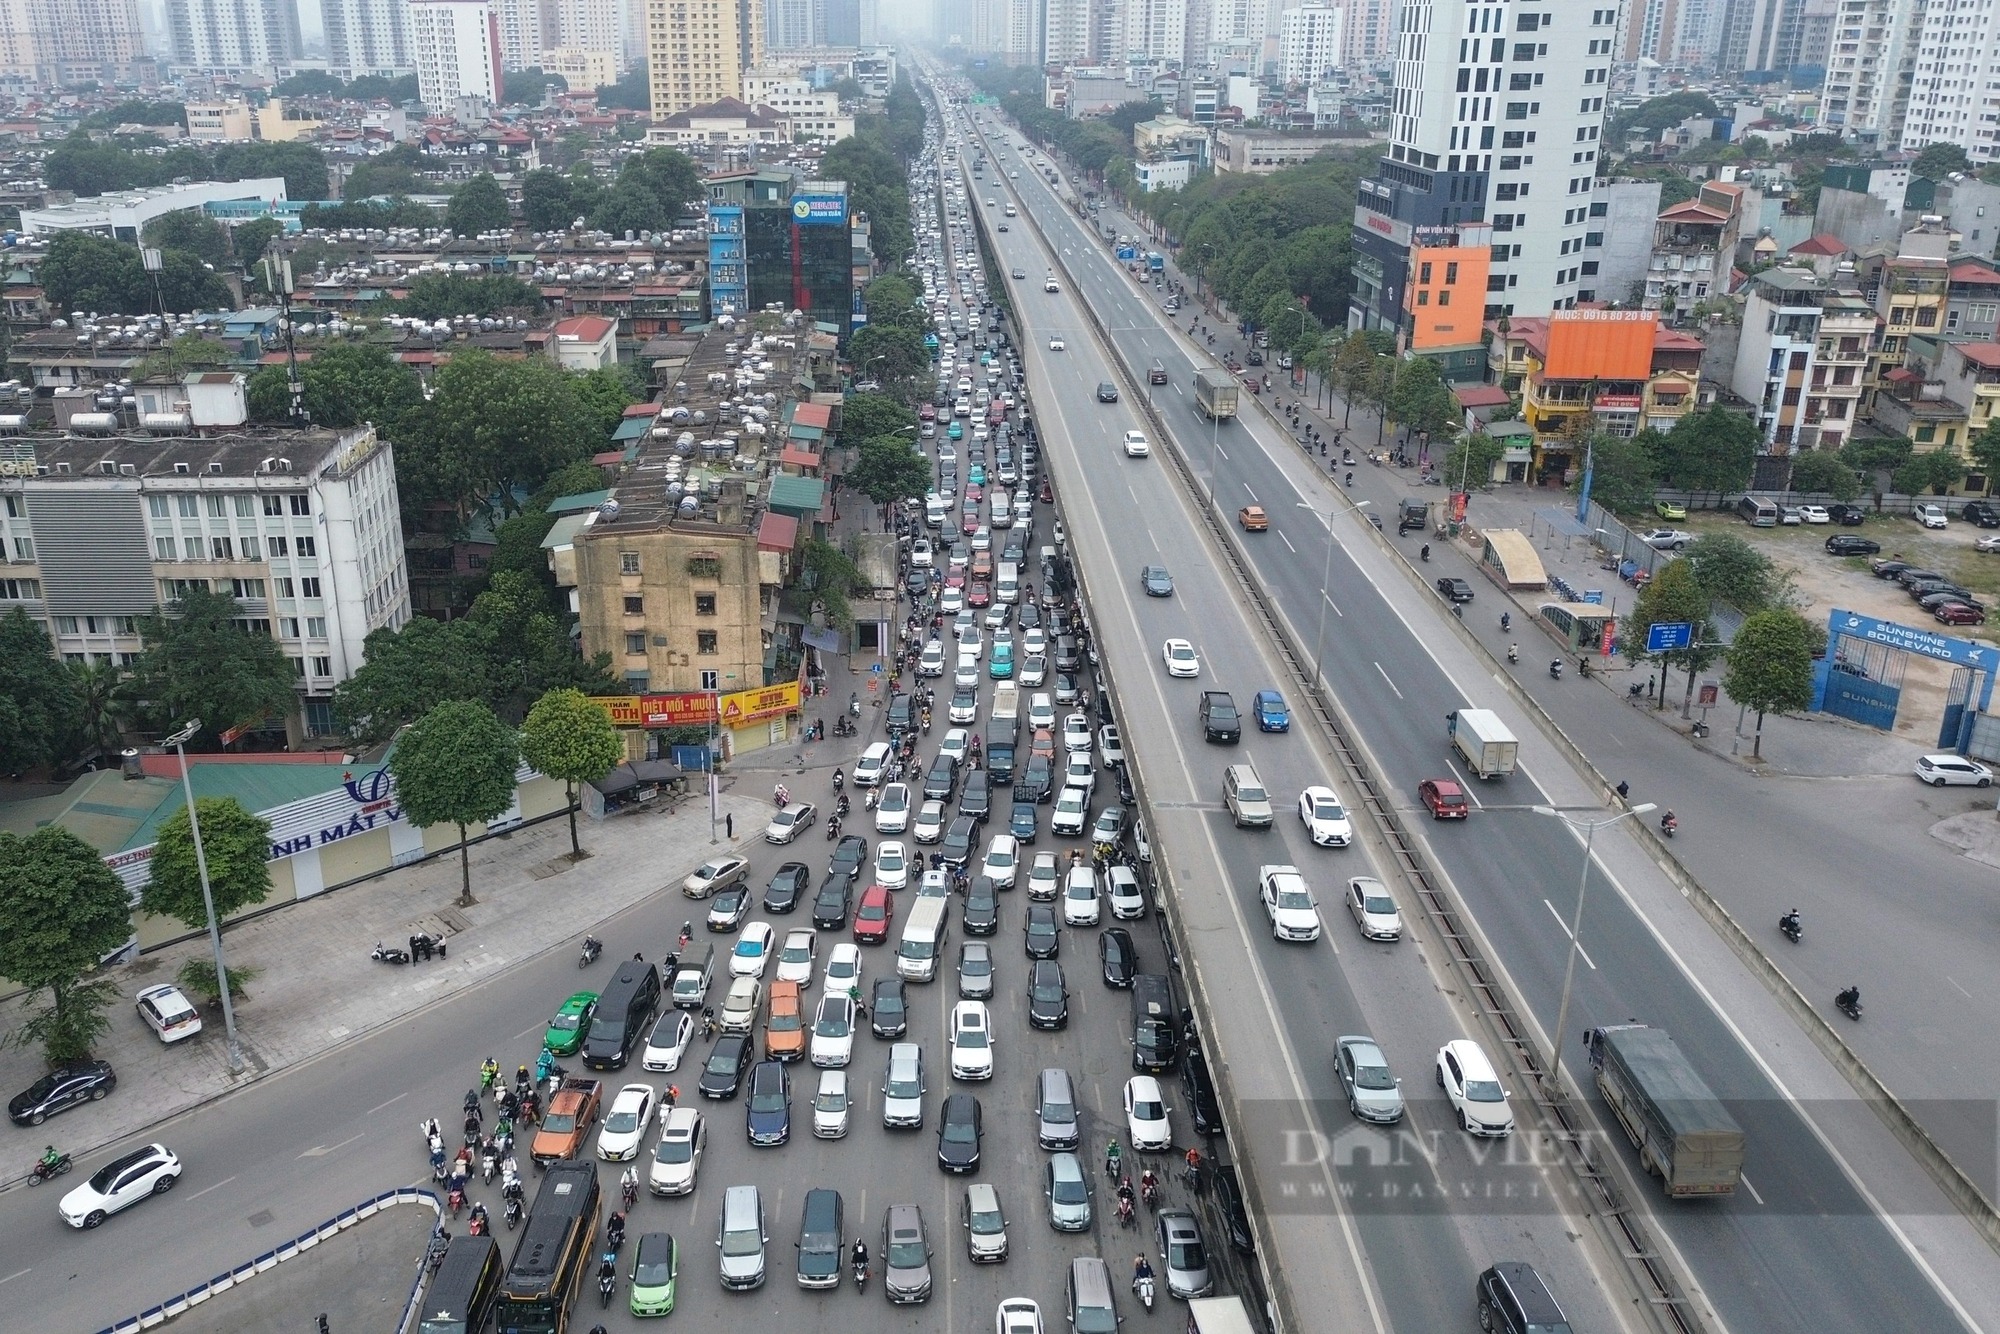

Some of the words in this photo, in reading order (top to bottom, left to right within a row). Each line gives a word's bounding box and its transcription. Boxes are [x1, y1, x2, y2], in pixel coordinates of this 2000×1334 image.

[1416, 224, 1430, 235] BỆNH
[1430, 224, 1443, 236] VIỆN
[1554, 310, 1580, 320] MQC:
[1625, 311, 1638, 320] 20
[1867, 630, 1951, 658] BOULEVARD
[1876, 623, 1946, 648] SUNSHINE
[642, 699, 663, 714] DIỆT
[665, 697, 684, 712] MỐI
